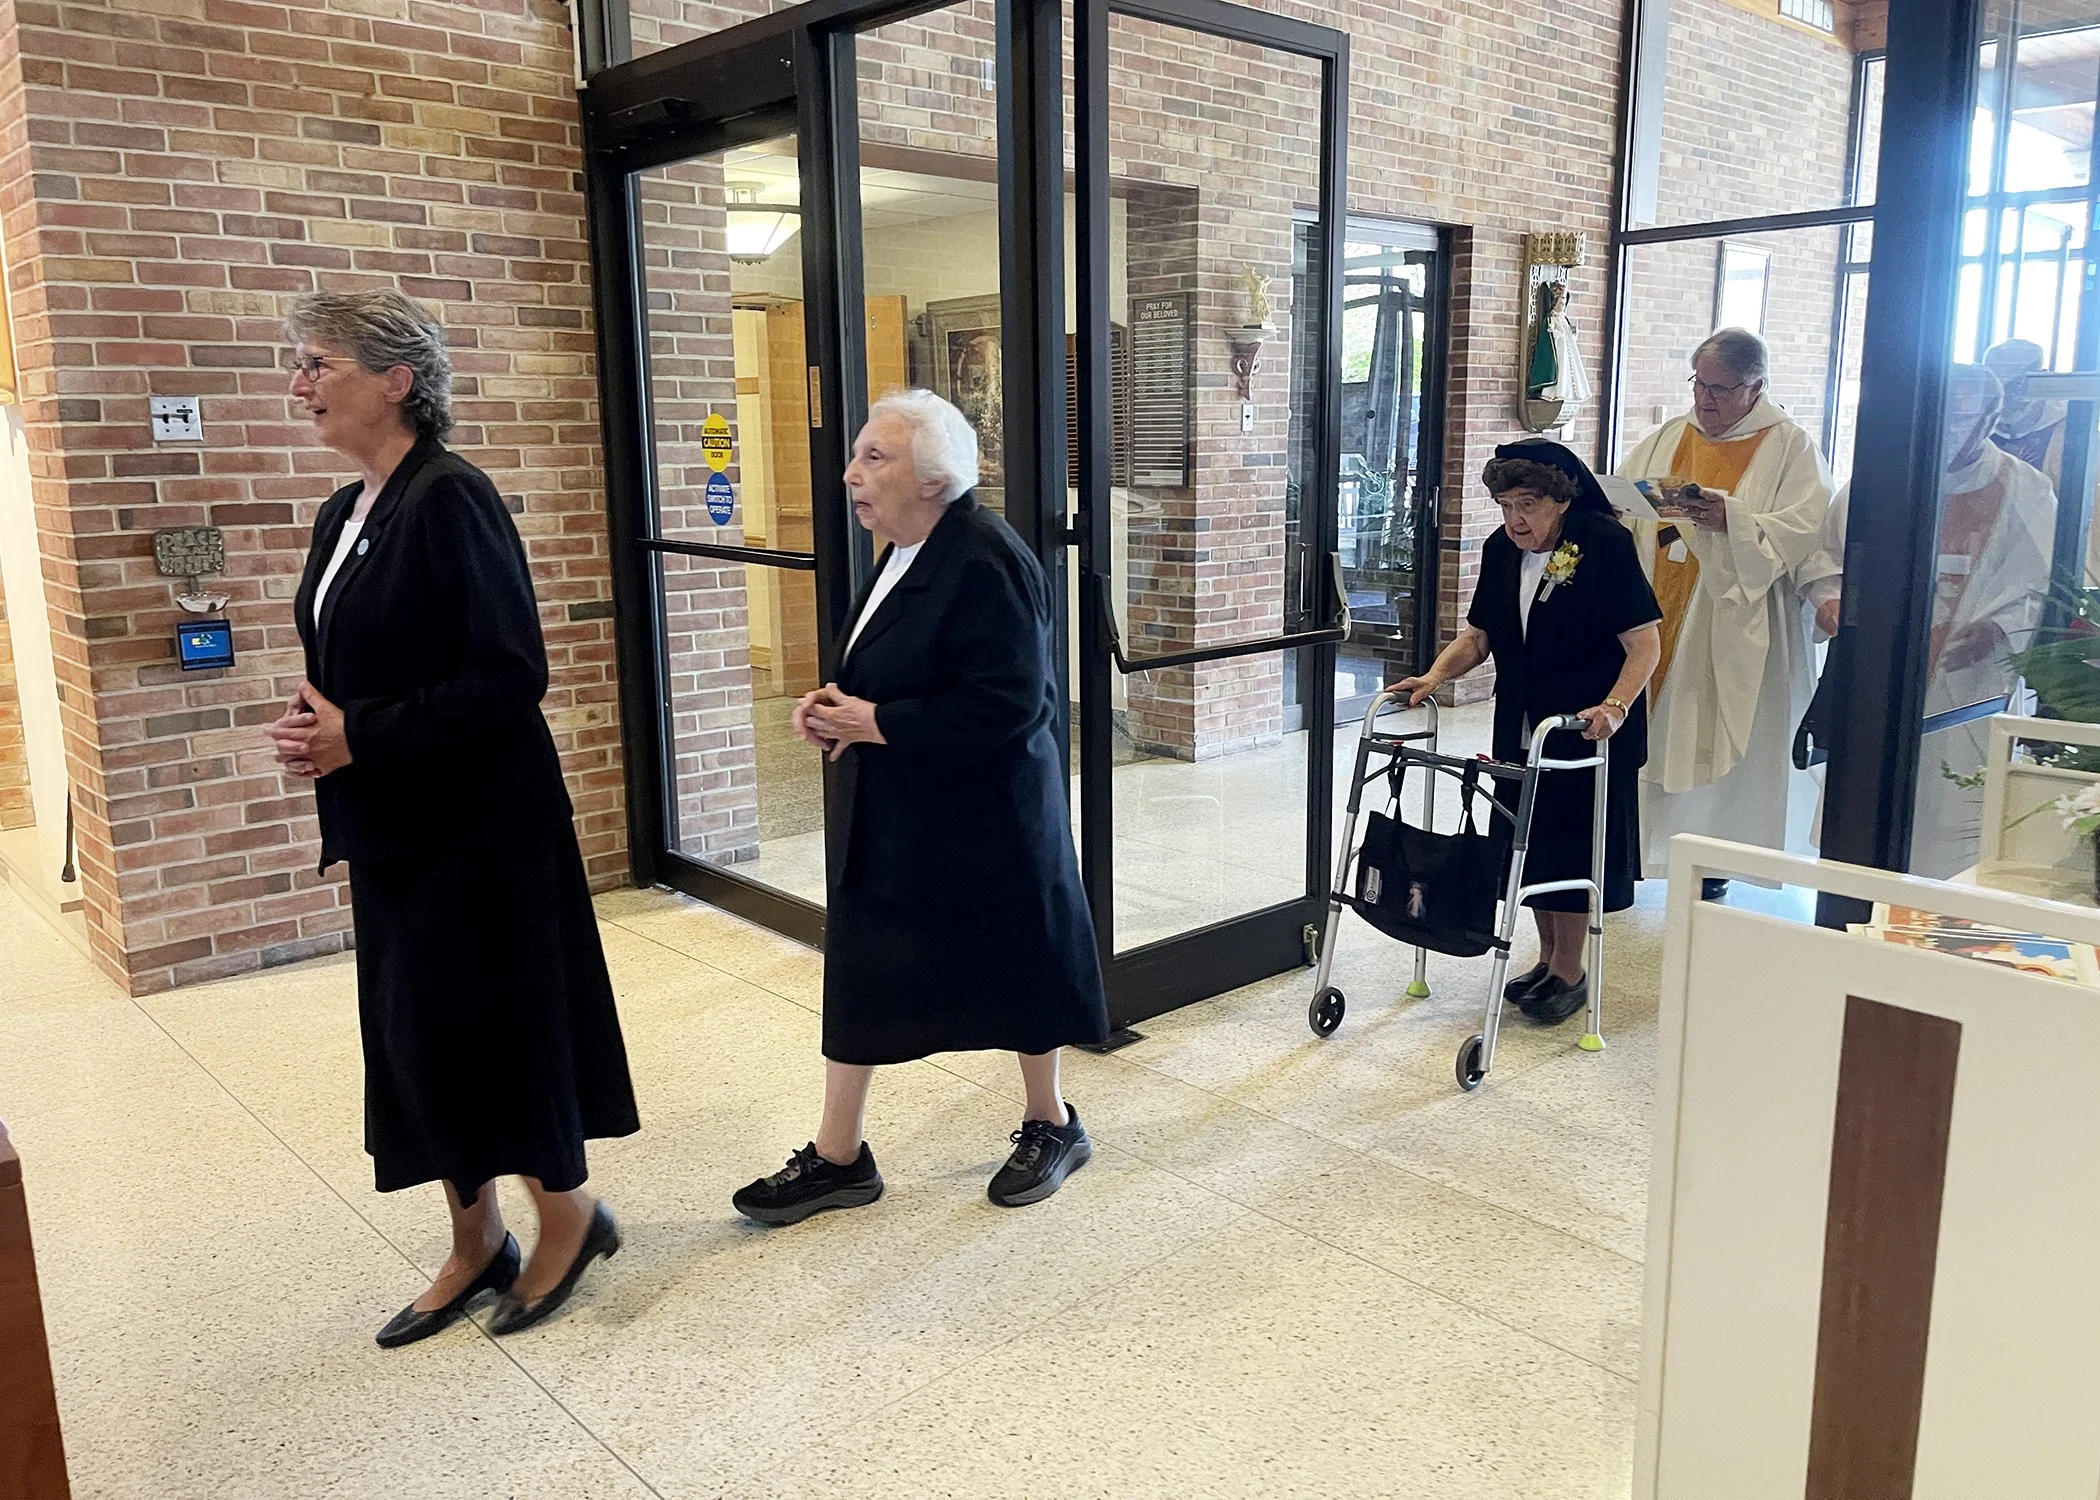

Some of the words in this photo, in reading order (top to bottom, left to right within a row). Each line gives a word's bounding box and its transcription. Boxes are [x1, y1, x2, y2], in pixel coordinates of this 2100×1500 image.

[1145, 302, 1160, 310] PRAY
[1161, 301, 1173, 309] FOR
[1140, 311, 1152, 319] OUR
[1153, 309, 1179, 318] BELOVED
[703, 437, 731, 448] CAUTION
[709, 505, 732, 514] OPERATE
[160, 530, 222, 552] PEACE
